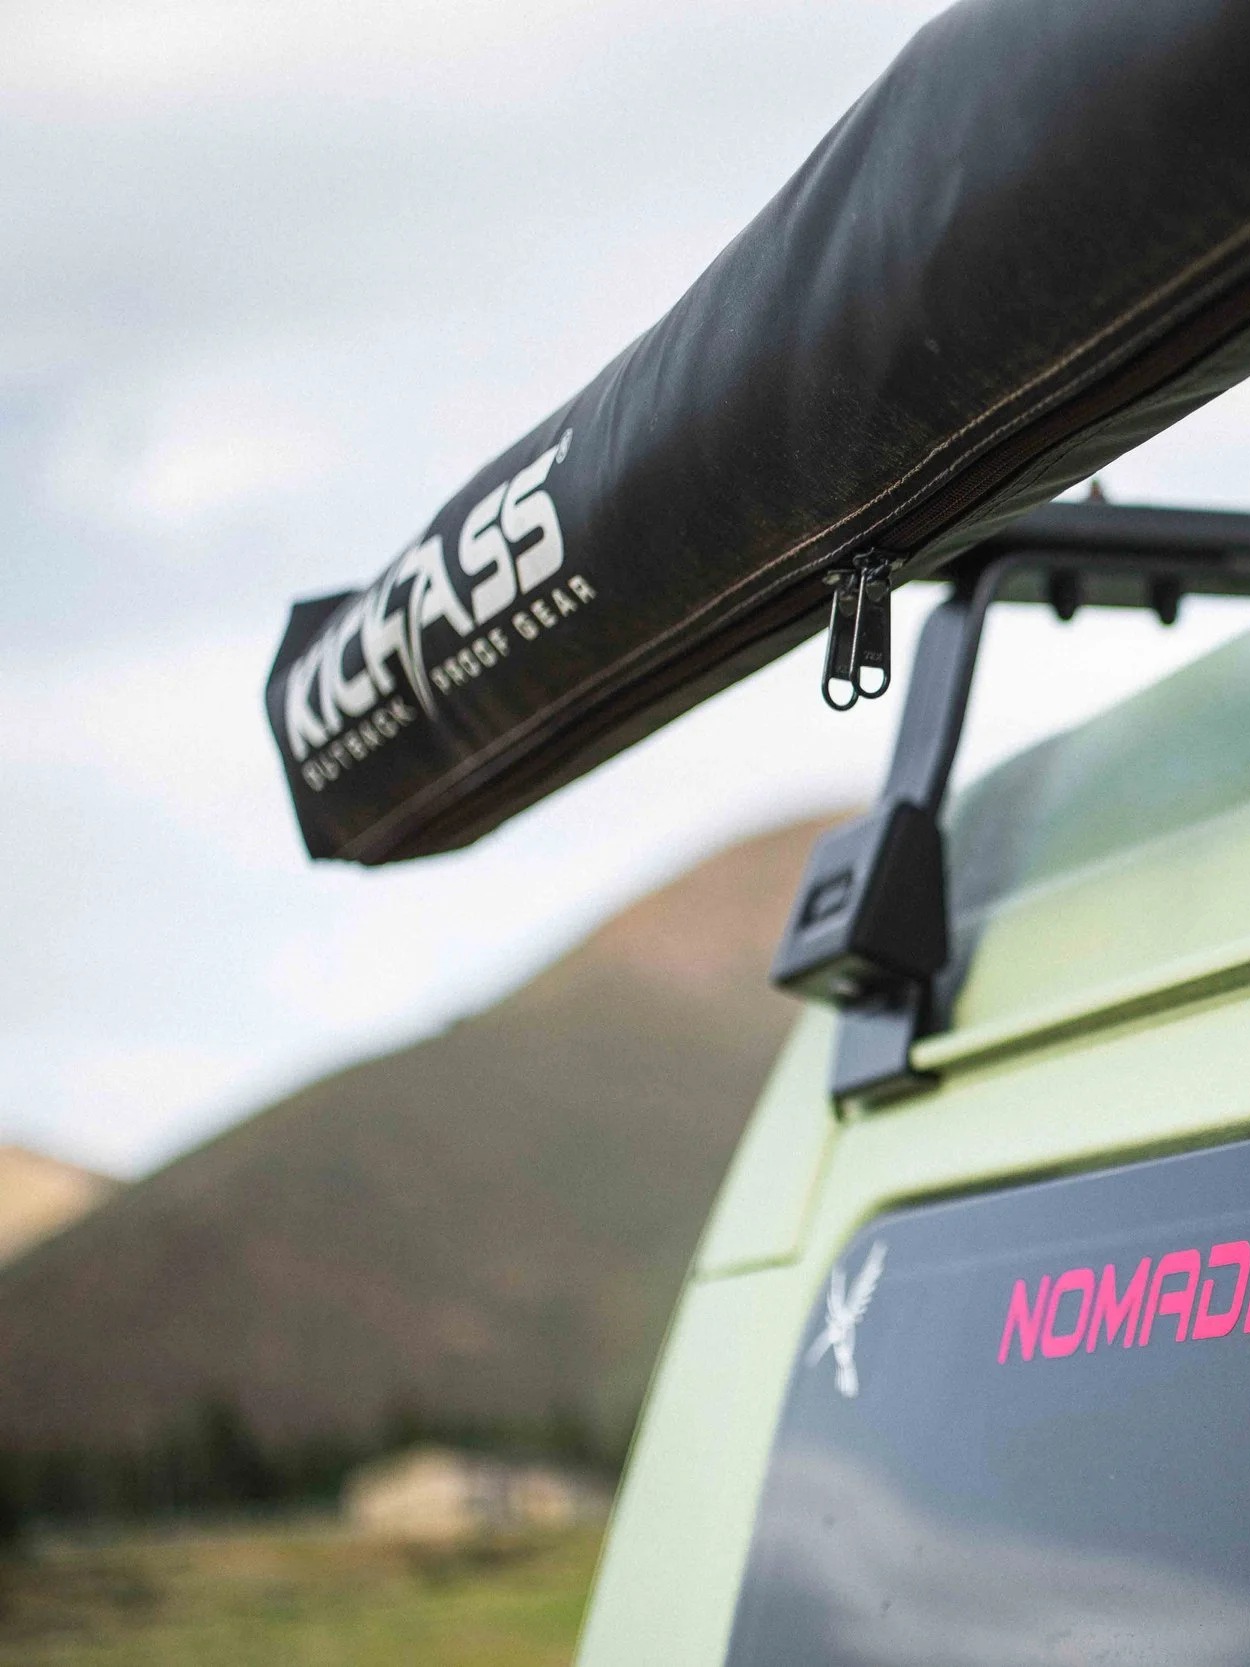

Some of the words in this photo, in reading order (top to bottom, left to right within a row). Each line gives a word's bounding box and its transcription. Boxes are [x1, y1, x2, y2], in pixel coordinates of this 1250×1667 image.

[301, 694, 417, 793] OUTBACK
[429, 627, 511, 696] PROOF
[511, 573, 598, 642] GEAR
